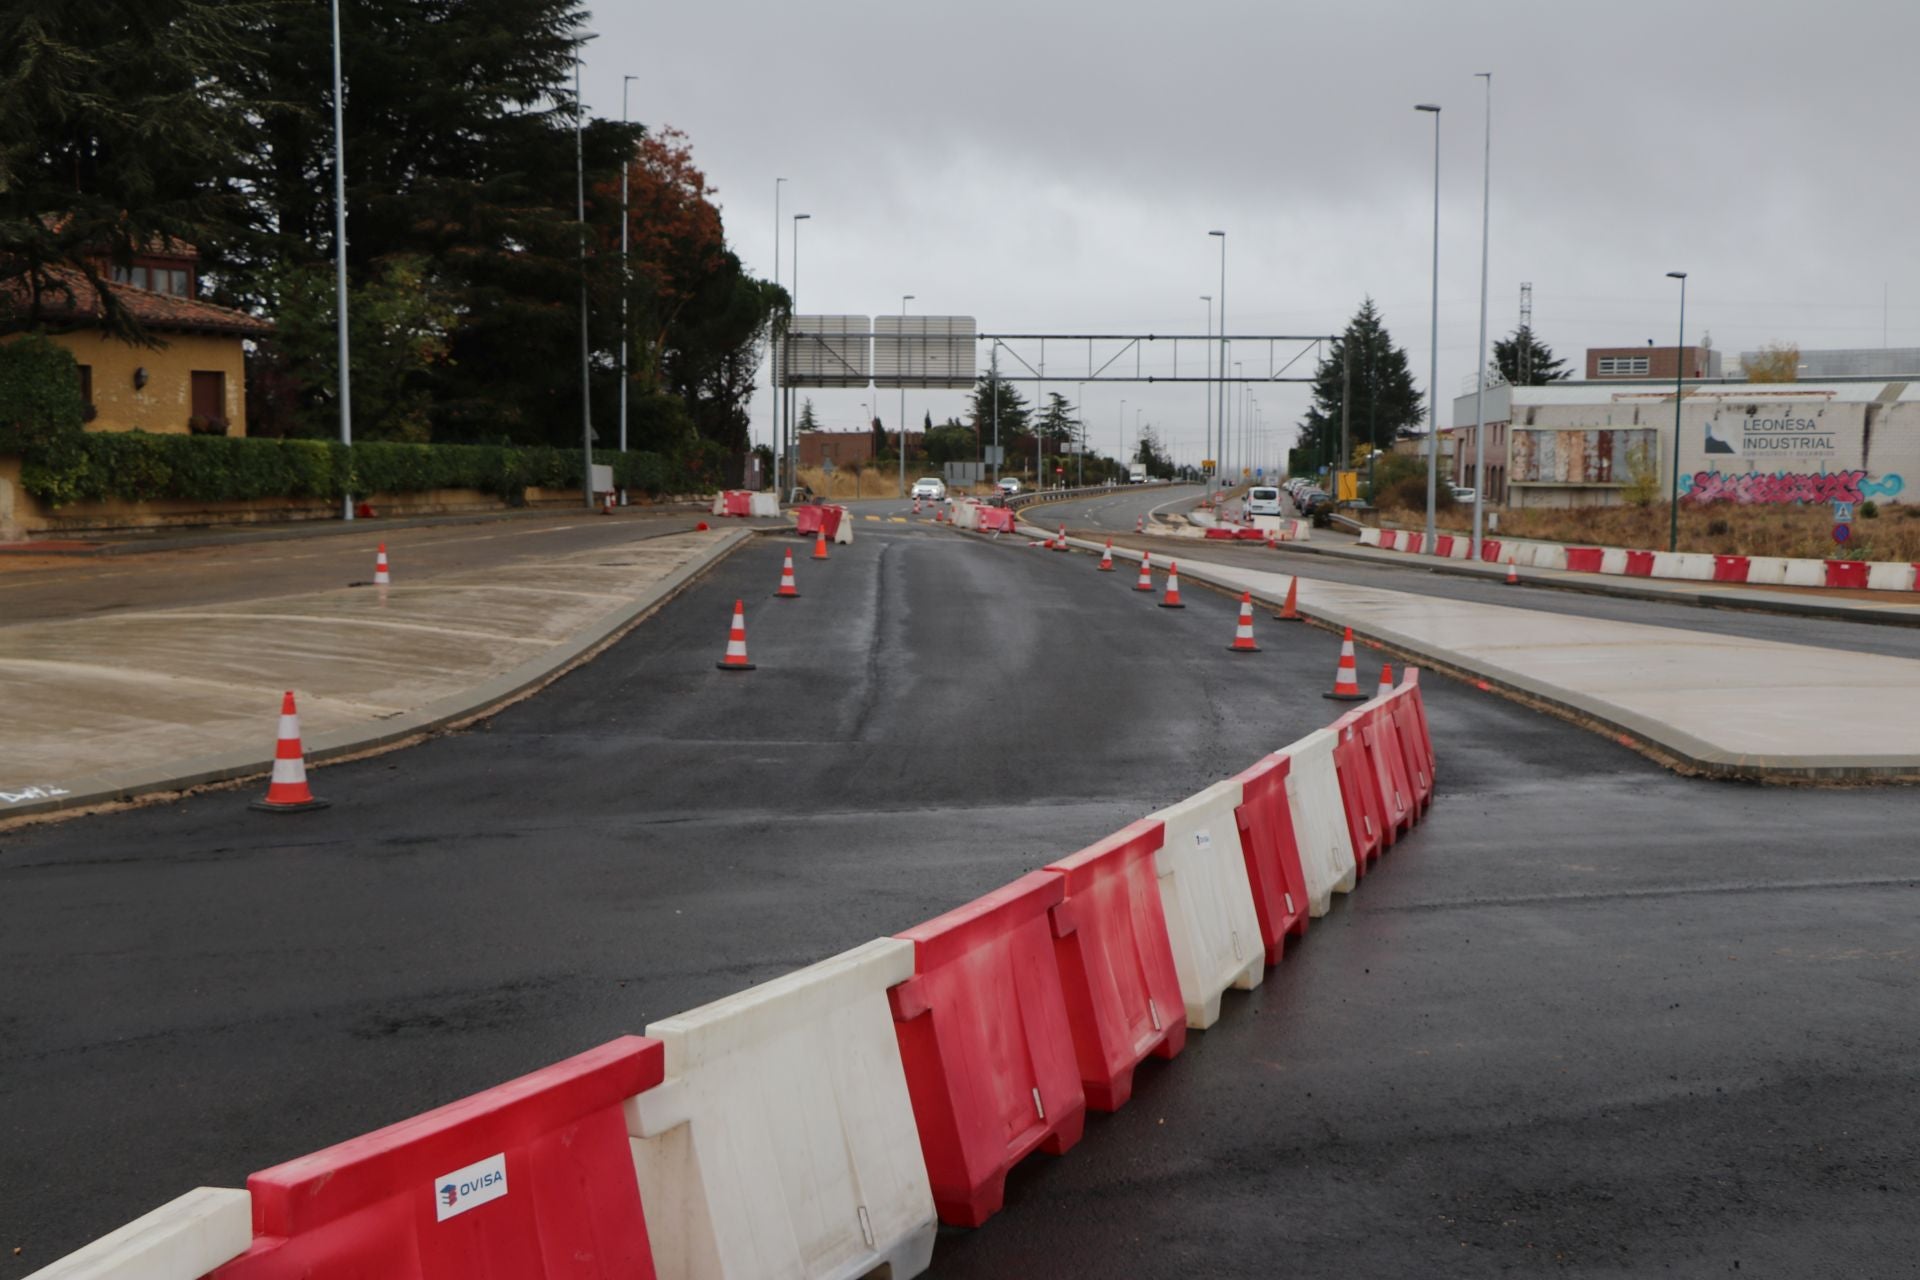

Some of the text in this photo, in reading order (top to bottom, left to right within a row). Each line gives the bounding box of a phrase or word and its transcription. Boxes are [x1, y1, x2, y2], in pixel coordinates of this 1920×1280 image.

[1743, 418, 1816, 432] LEONESA
[1743, 437, 1835, 449] INDUSTRIAL
[460, 1170, 503, 1196] OVISA
